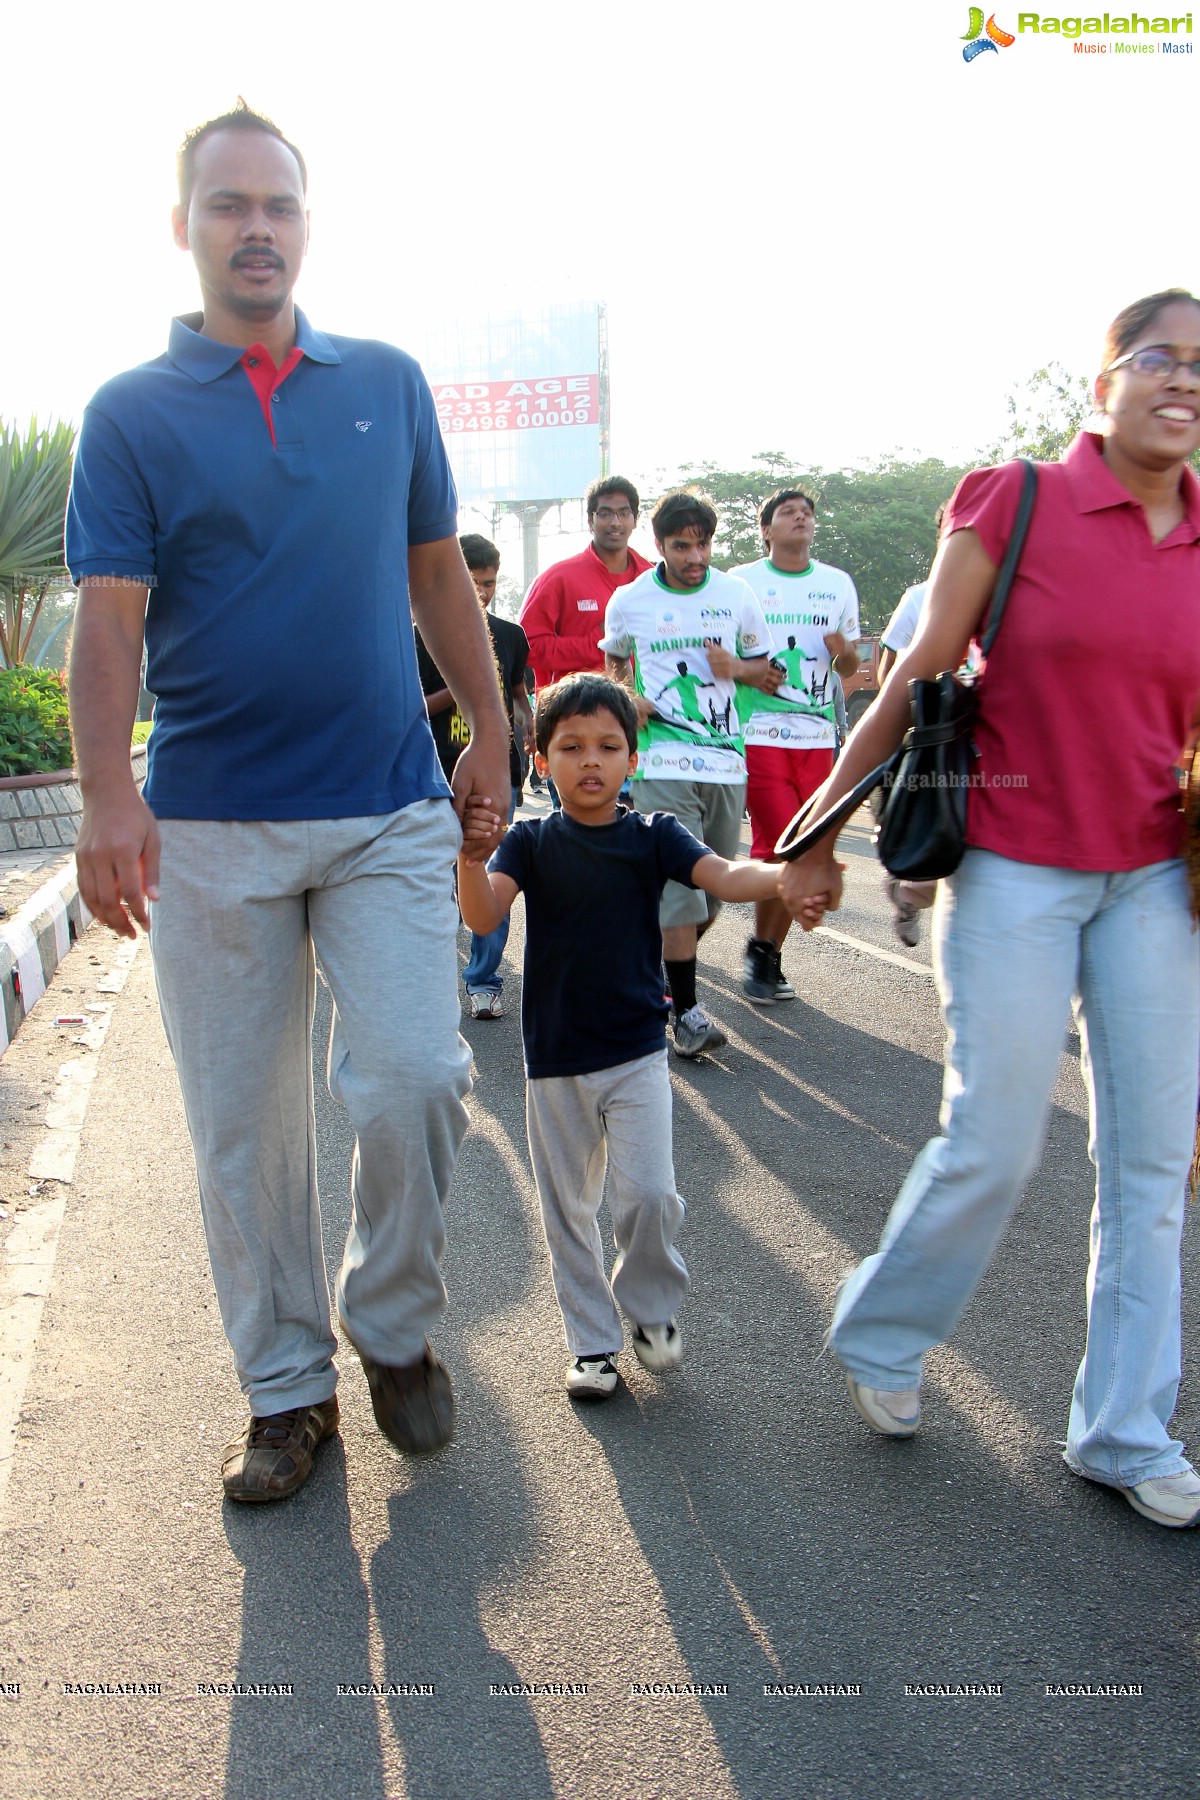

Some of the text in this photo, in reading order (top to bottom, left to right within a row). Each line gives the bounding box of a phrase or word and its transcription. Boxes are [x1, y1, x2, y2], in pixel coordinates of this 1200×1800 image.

[437, 377, 590, 401] AD AGE
[437, 394, 592, 417] 23321112
[440, 409, 589, 433] 99496 00009
[764, 613, 829, 627] HARITHON
